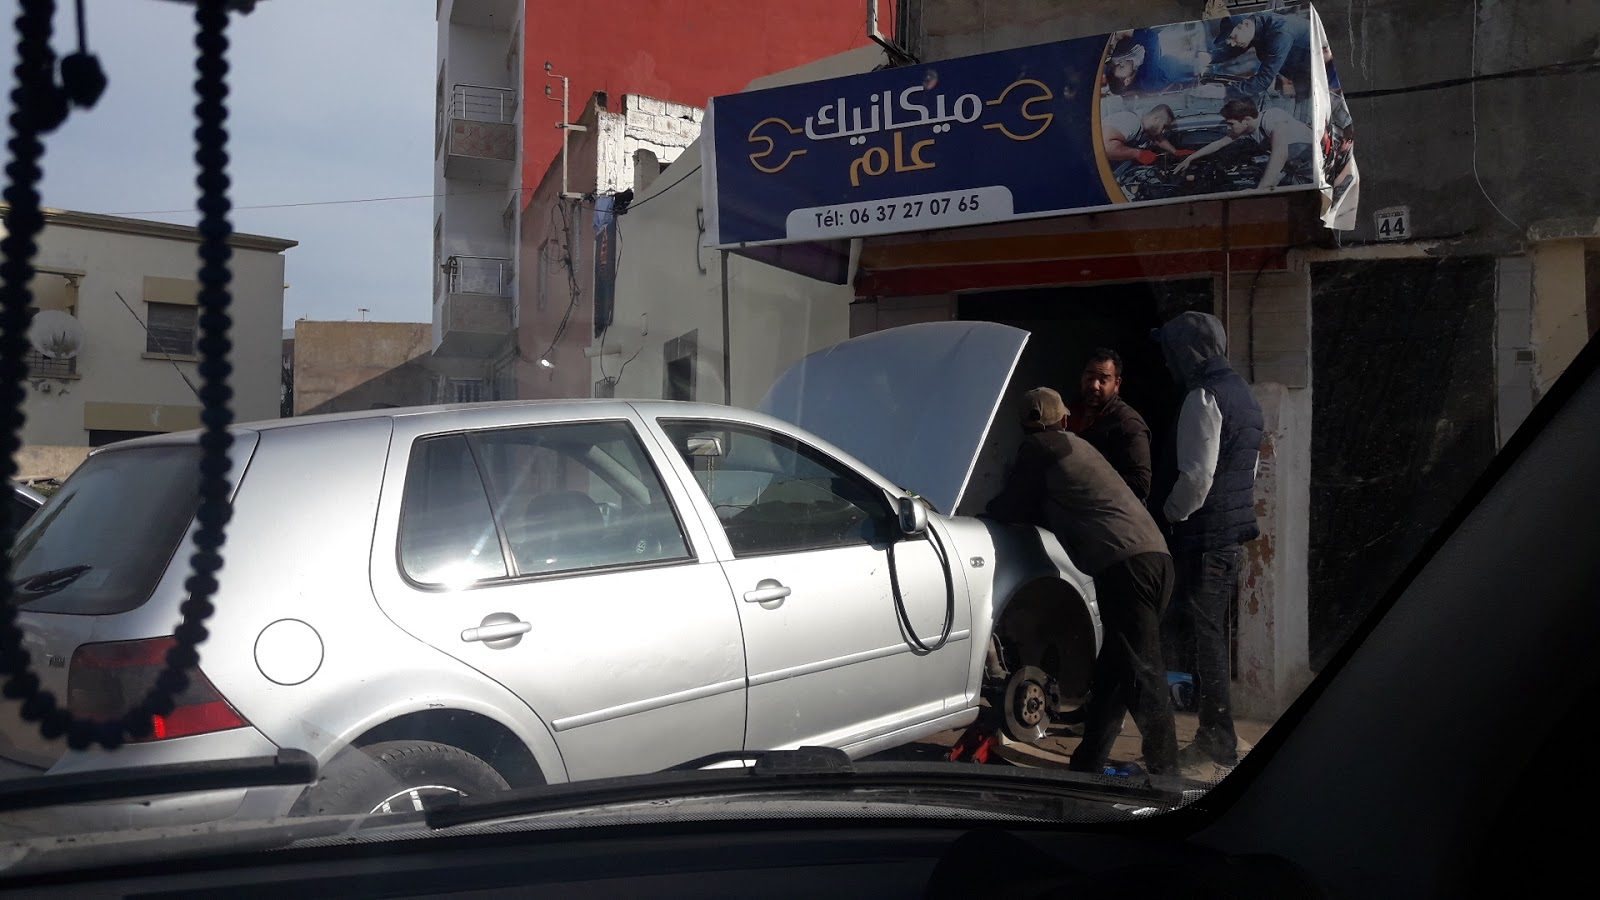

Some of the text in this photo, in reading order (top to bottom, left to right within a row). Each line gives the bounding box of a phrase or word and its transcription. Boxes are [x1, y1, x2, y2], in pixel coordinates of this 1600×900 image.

[805, 86, 982, 146] ميكانيك
[850, 131, 936, 187] عام
[815, 195, 980, 228] Tél: 06 37 27 07 65
[1380, 217, 1405, 236] 44
